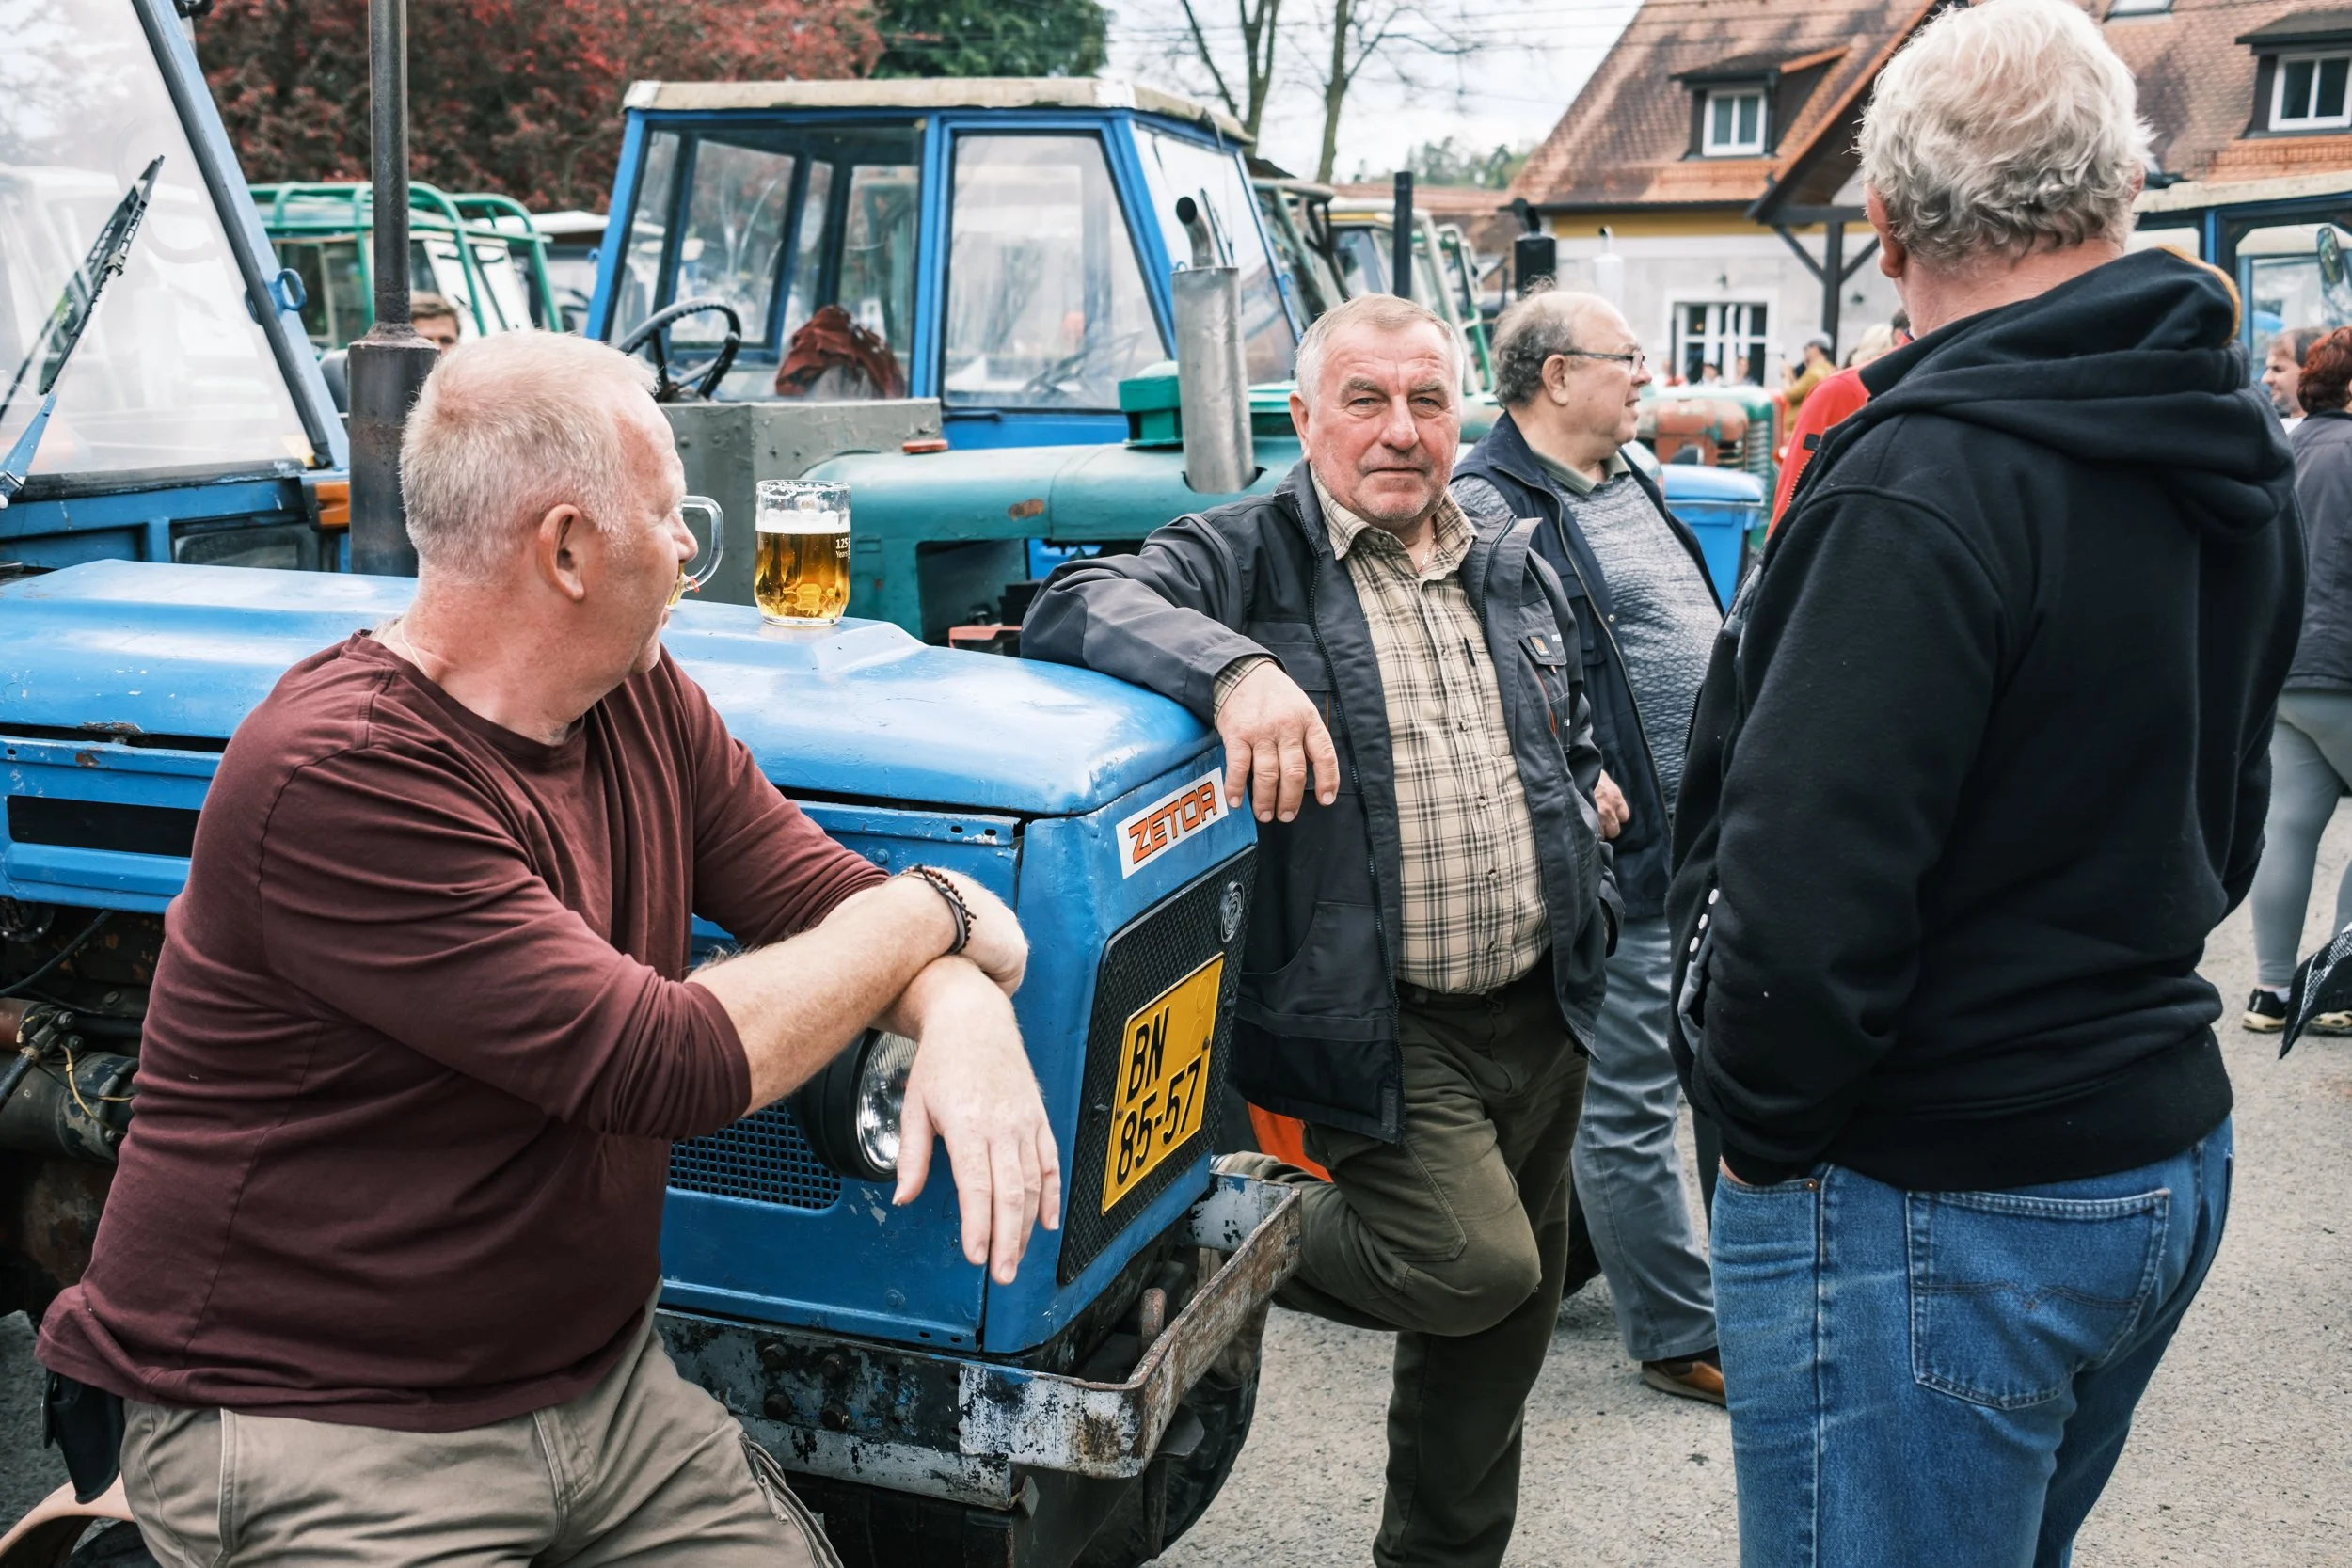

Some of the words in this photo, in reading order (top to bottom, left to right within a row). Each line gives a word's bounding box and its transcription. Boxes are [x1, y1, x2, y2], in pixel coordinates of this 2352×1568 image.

[835, 537, 848, 549] 125
[1128, 781, 1217, 864] ZETOR
[1126, 1006, 1169, 1104] BN
[1116, 1054, 1202, 1186] 85-57
